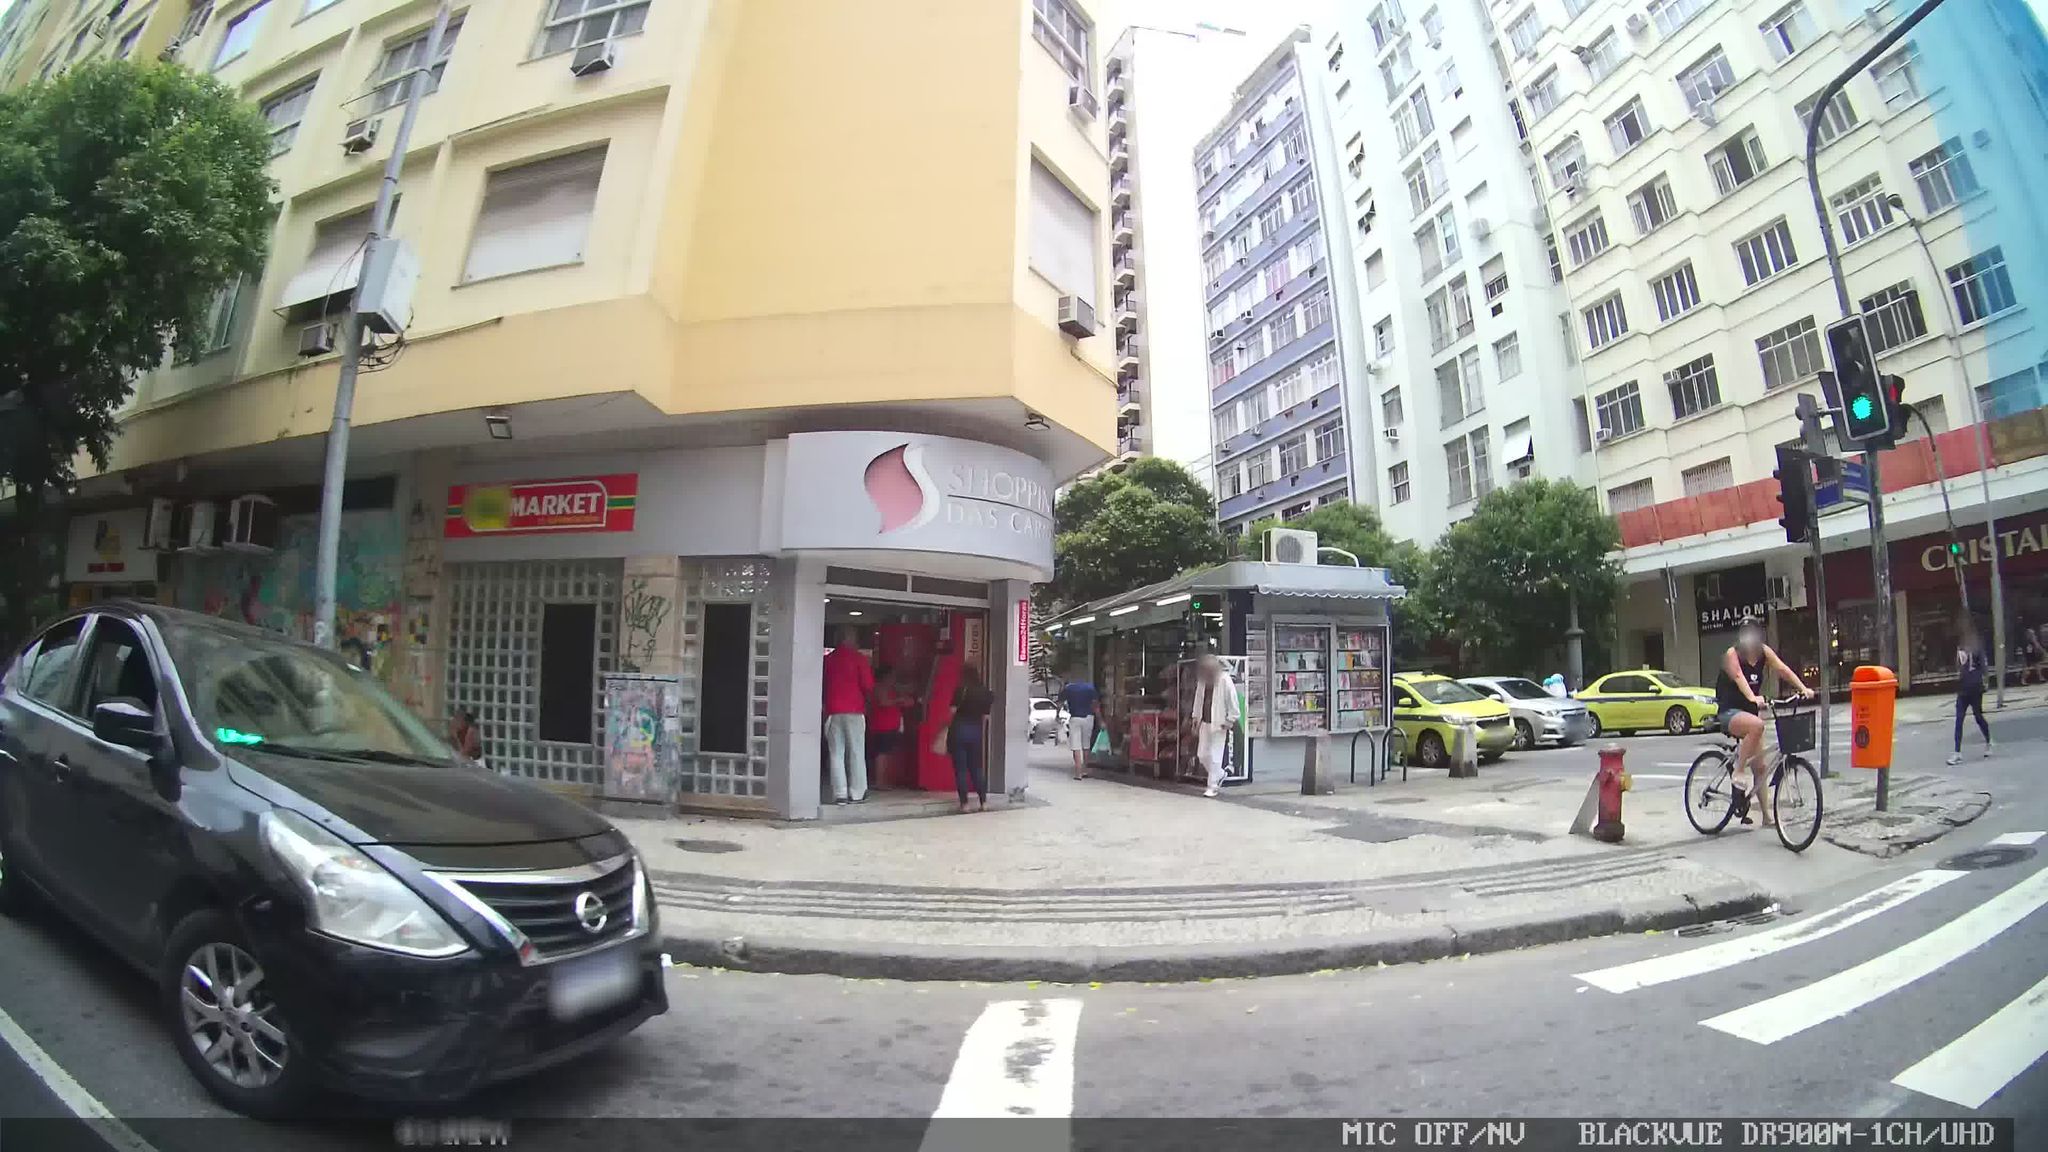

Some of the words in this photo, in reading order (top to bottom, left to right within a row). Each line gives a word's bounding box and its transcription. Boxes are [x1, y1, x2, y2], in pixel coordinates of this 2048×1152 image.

[510, 493, 603, 518] MARKET
[947, 501, 998, 529] DAS
[1702, 603, 1764, 623] SHALOM
